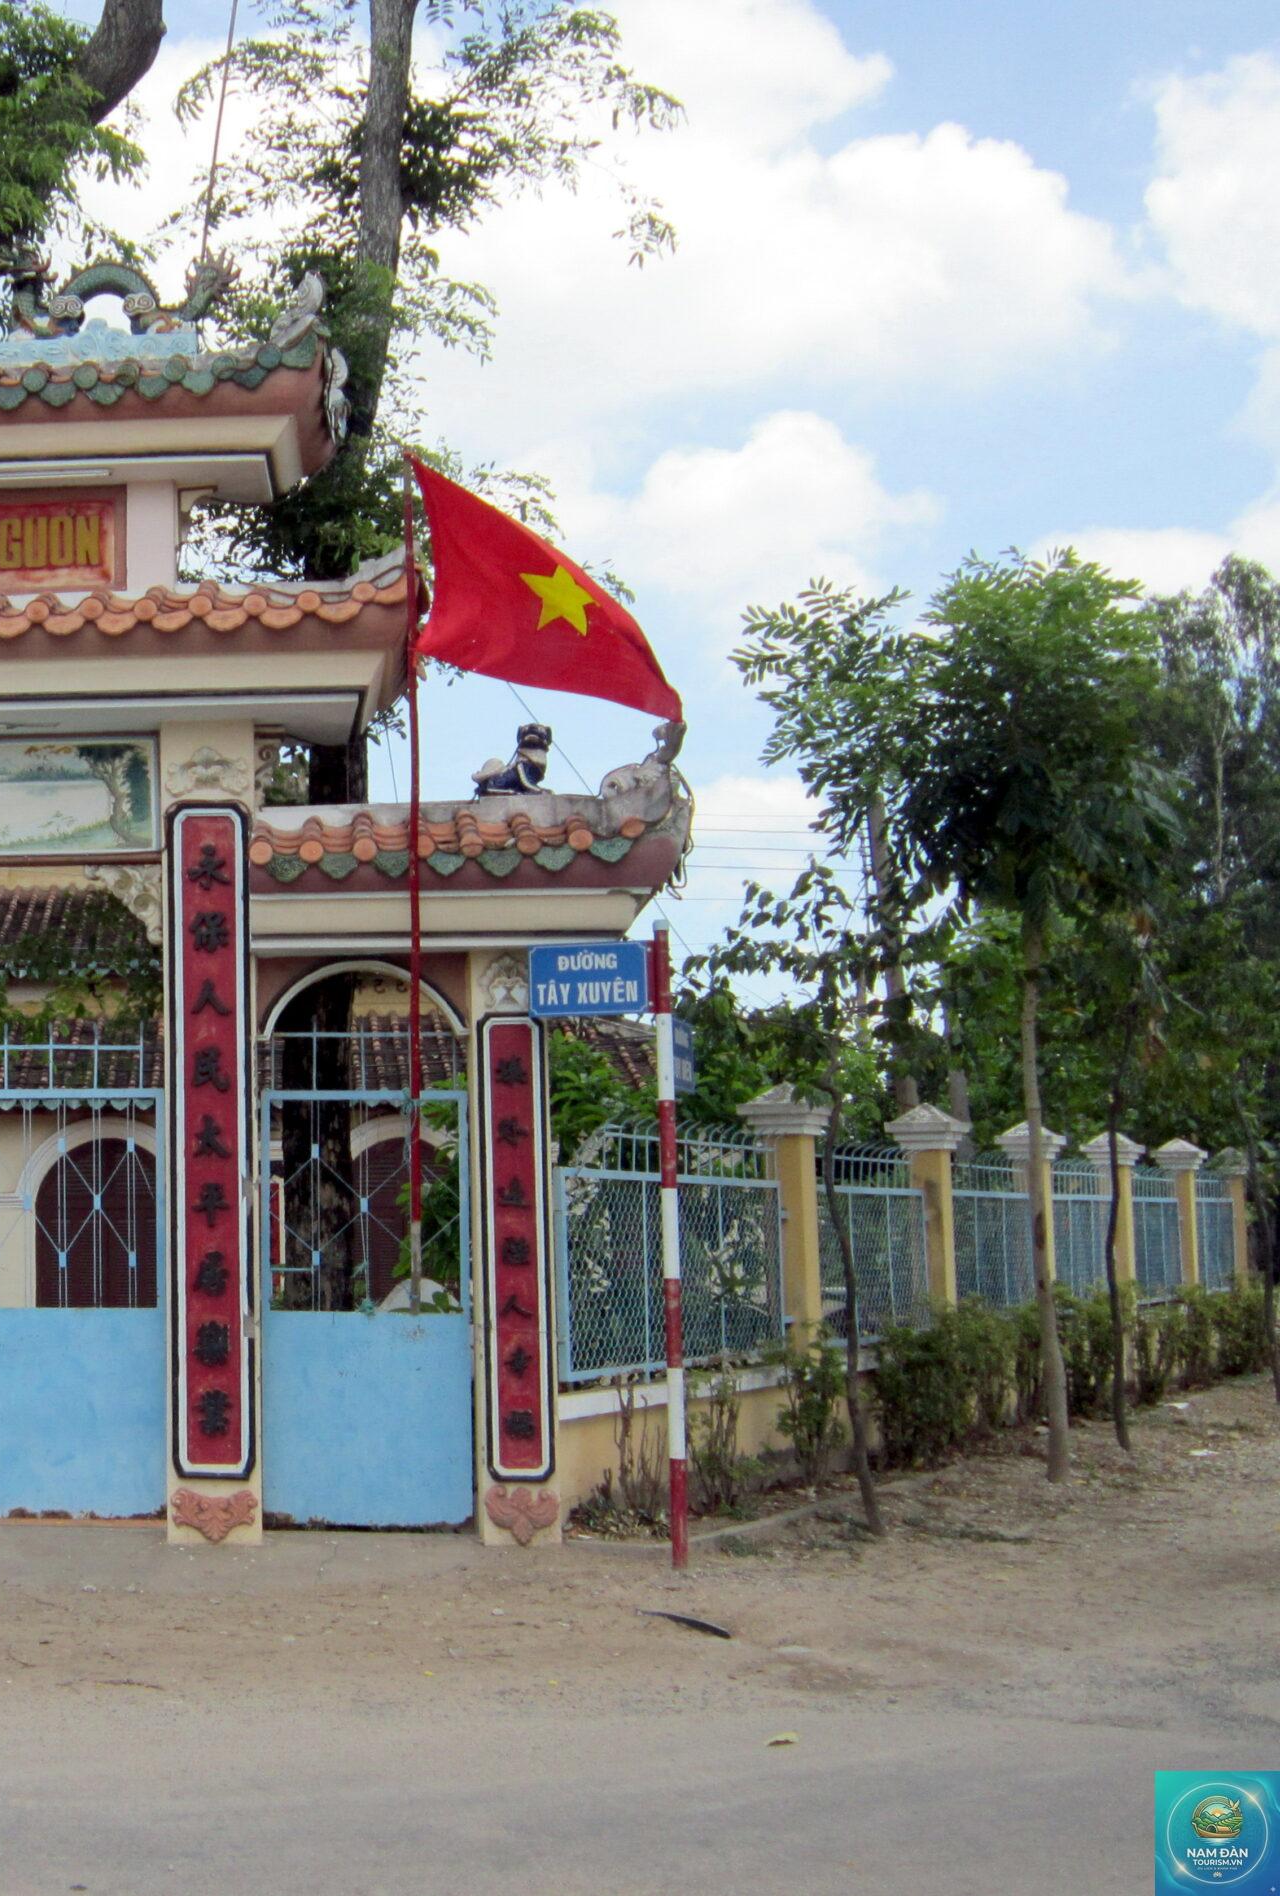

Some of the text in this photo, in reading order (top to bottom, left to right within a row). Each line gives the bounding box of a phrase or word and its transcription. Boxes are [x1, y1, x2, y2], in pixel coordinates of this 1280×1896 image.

[558, 950, 617, 972] ĐƯỜNG
[537, 976, 638, 1006] TÂY XUYÊN
